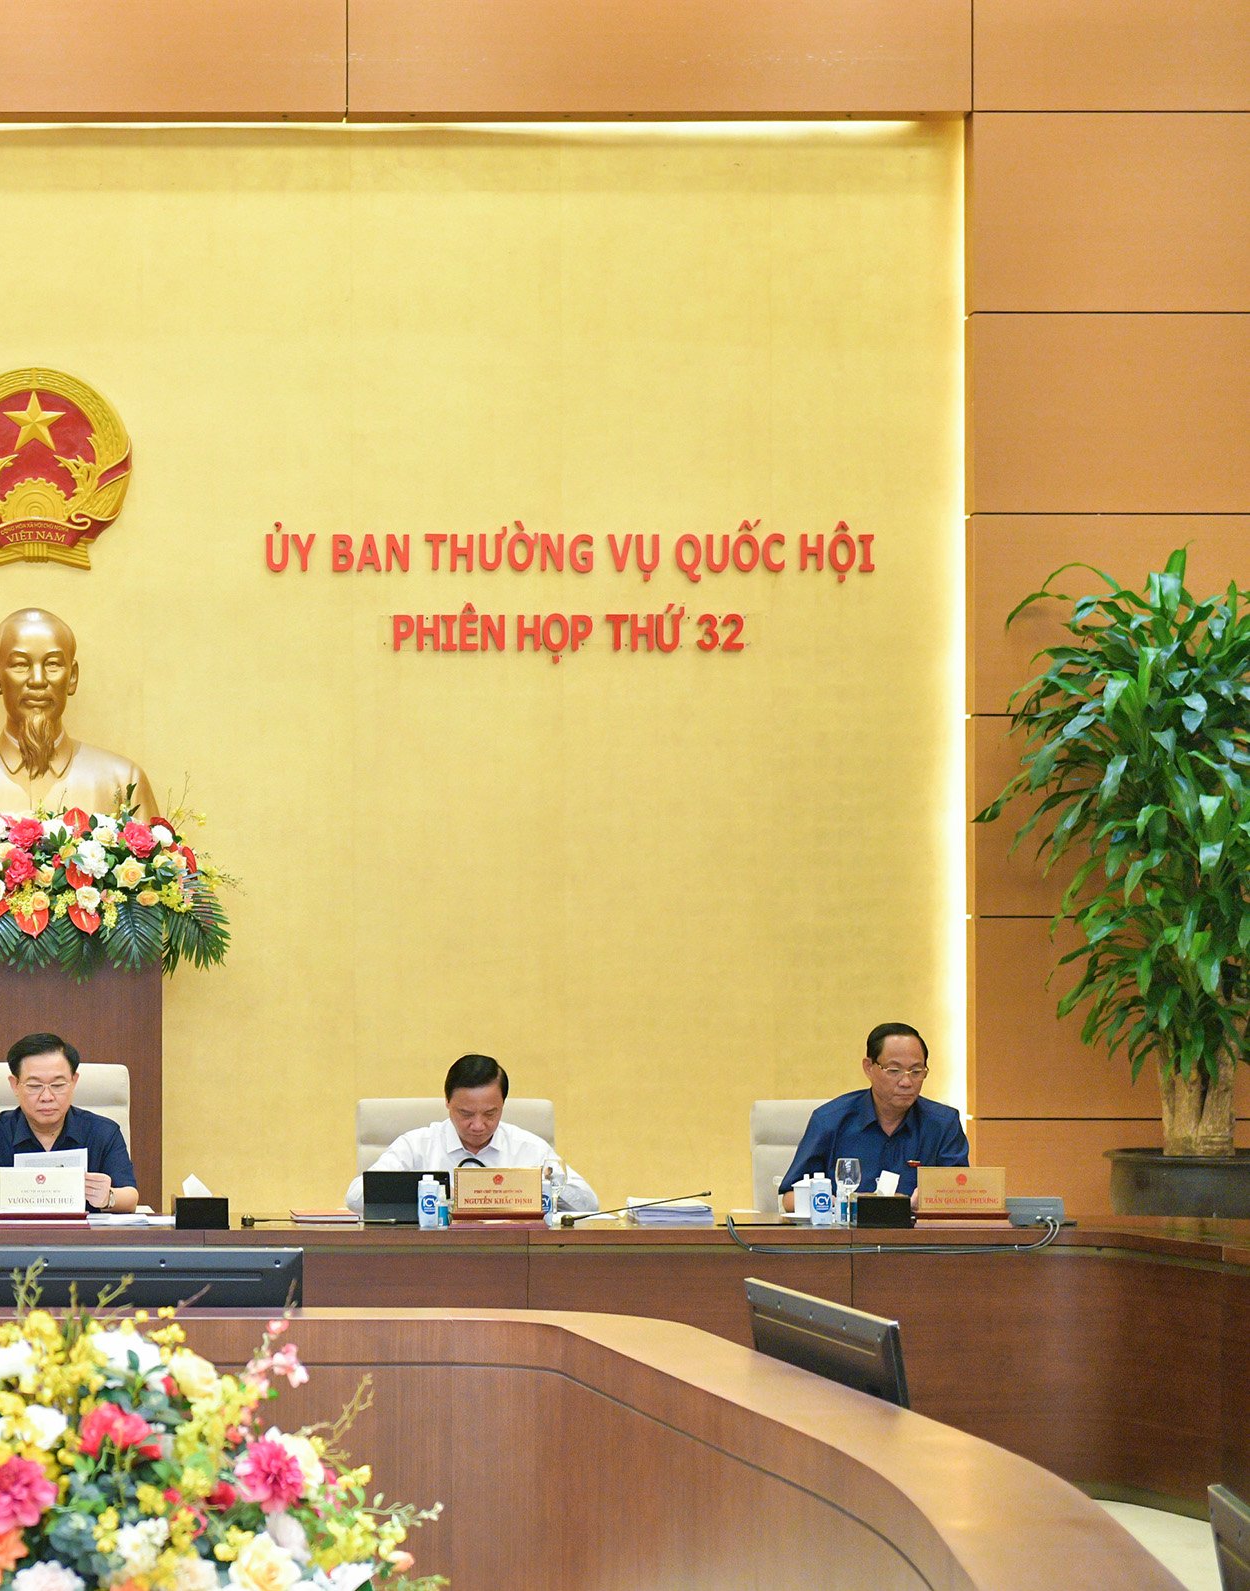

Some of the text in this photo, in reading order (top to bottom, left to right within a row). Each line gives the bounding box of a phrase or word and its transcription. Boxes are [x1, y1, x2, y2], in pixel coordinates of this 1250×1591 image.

[36, 531, 66, 543] NAM
[266, 520, 875, 582] ỦY BAN THƯỜNG VỤ QUỐC HỘI
[393, 603, 745, 664] PHIÊN HỌP THỨ 32
[815, 1196, 830, 1205] ICY
